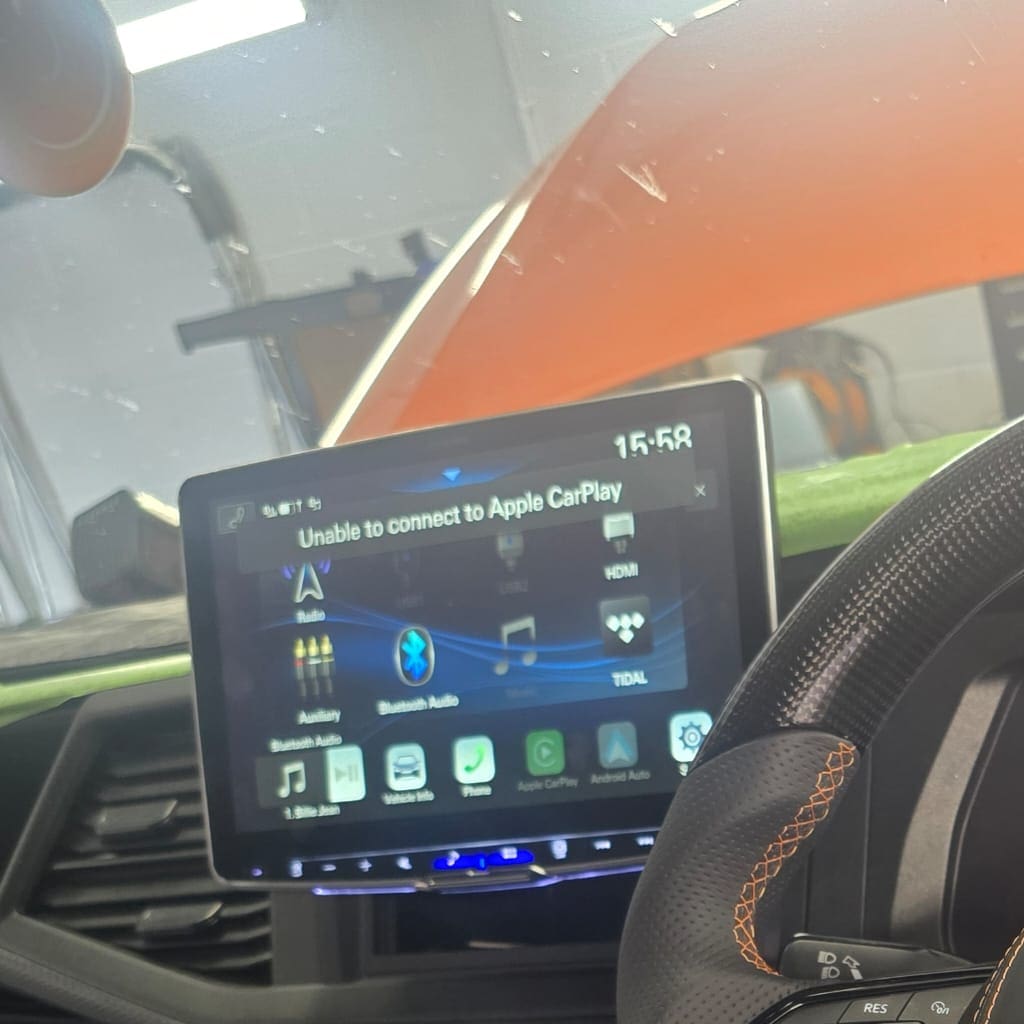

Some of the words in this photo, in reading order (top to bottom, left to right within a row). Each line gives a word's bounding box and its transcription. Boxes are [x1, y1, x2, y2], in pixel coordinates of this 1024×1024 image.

[614, 422, 693, 460] 15:58
[299, 521, 361, 549] Unable
[364, 519, 384, 539] to
[387, 506, 461, 535] connect
[463, 504, 484, 522] to
[488, 490, 544, 521] Apple
[547, 480, 623, 510] CarPlay
[604, 562, 639, 580] HDMI
[612, 670, 648, 688] TIDAL
[377, 699, 427, 715] Bluetooth
[518, 780, 543, 793] Apple
[545, 777, 578, 790] CarPlay
[591, 773, 627, 785] Android
[628, 770, 650, 781] Auto
[863, 1003, 888, 1014] RES
